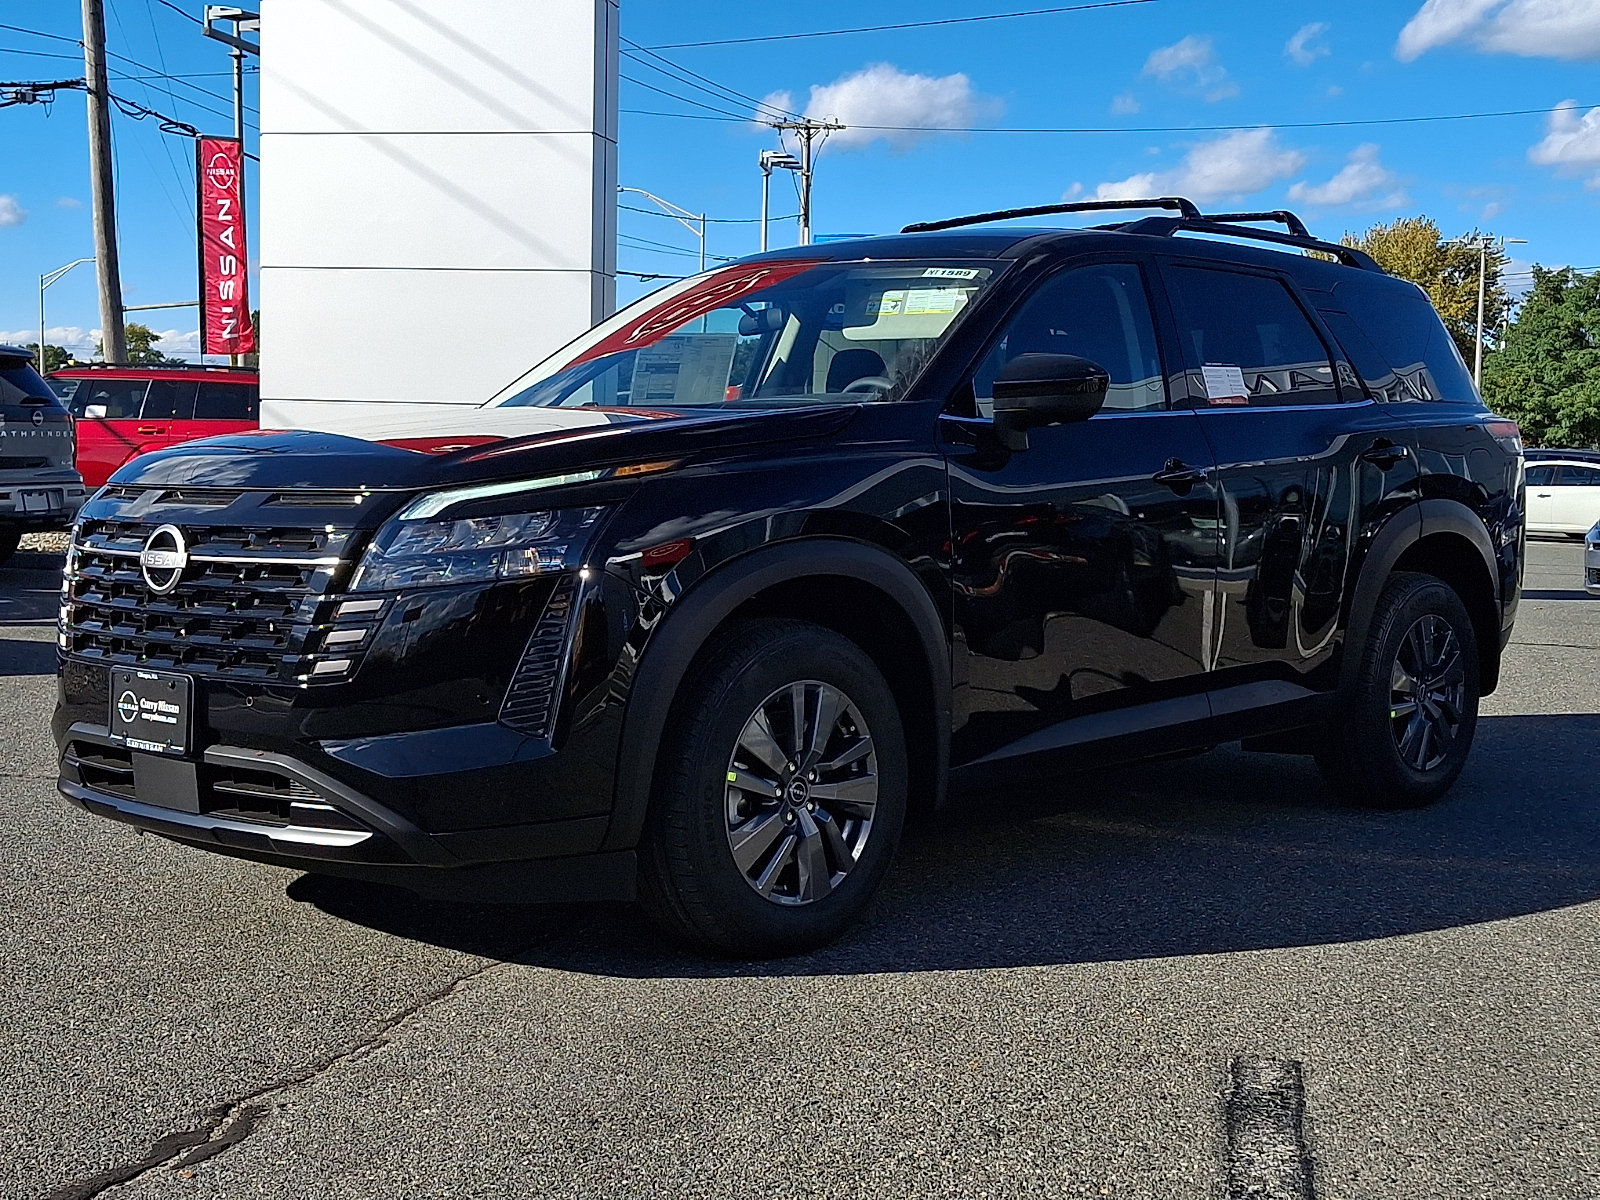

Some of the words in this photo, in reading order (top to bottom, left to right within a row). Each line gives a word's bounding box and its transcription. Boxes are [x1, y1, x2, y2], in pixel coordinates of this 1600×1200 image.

[206, 168, 235, 176] NISSAN
[217, 199, 239, 339] NISSAN
[141, 553, 185, 566] NISSAN
